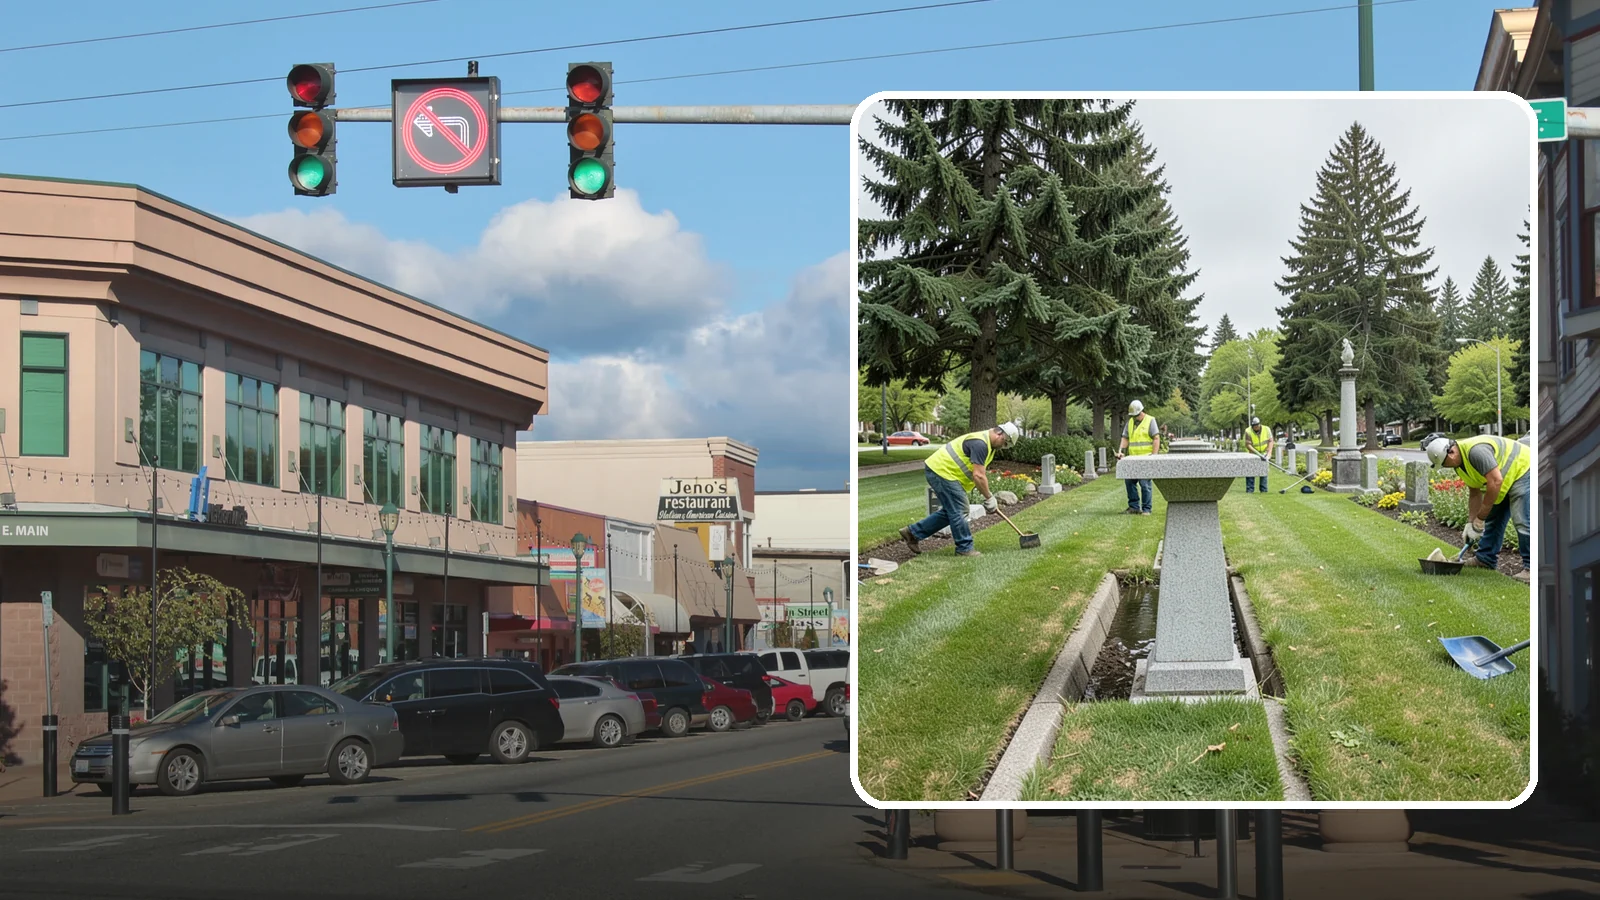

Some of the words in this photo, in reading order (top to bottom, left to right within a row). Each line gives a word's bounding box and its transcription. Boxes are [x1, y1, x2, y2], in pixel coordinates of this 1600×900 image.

[670, 480, 727, 494] Jeno's
[665, 497, 731, 509] restaurant
[659, 510, 681, 519] Italian
[686, 510, 714, 519] American
[714, 510, 737, 519] Cuisine
[2, 525, 13, 536] E.
[15, 525, 49, 536] MAIN
[797, 608, 828, 616] Street
